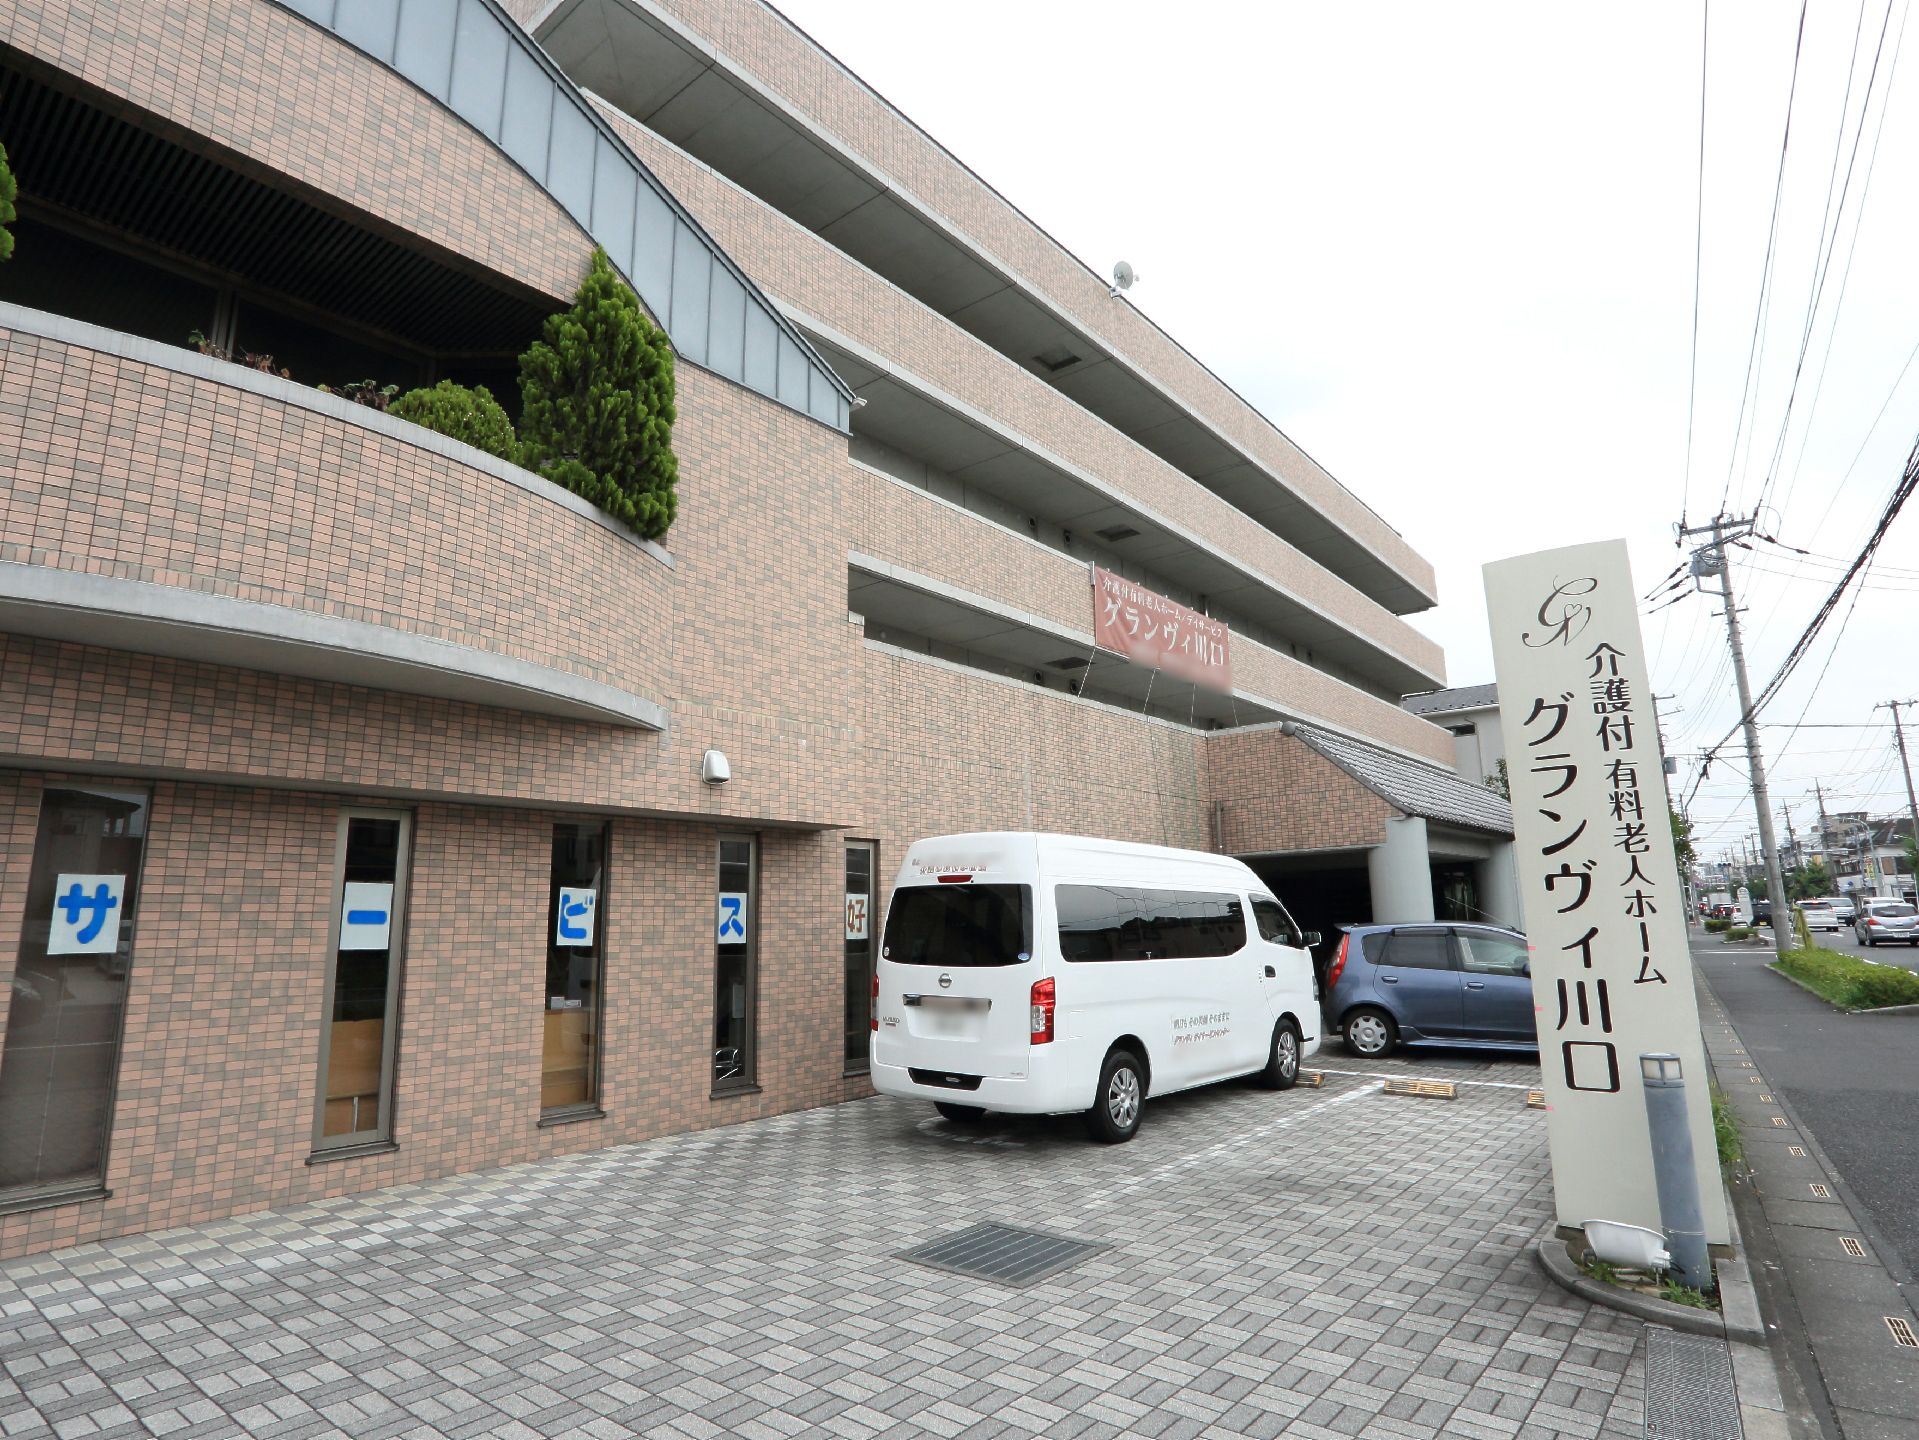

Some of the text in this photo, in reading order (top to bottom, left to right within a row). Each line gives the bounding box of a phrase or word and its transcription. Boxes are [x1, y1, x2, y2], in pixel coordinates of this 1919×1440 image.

[1103, 597, 1224, 666] グランヴィ川口
[57, 883, 118, 945] サ
[719, 897, 744, 938] ス
[1523, 691, 1622, 1093] グランヴィ川口
[1585, 642, 1668, 985] 介護付有料老人ホーム
